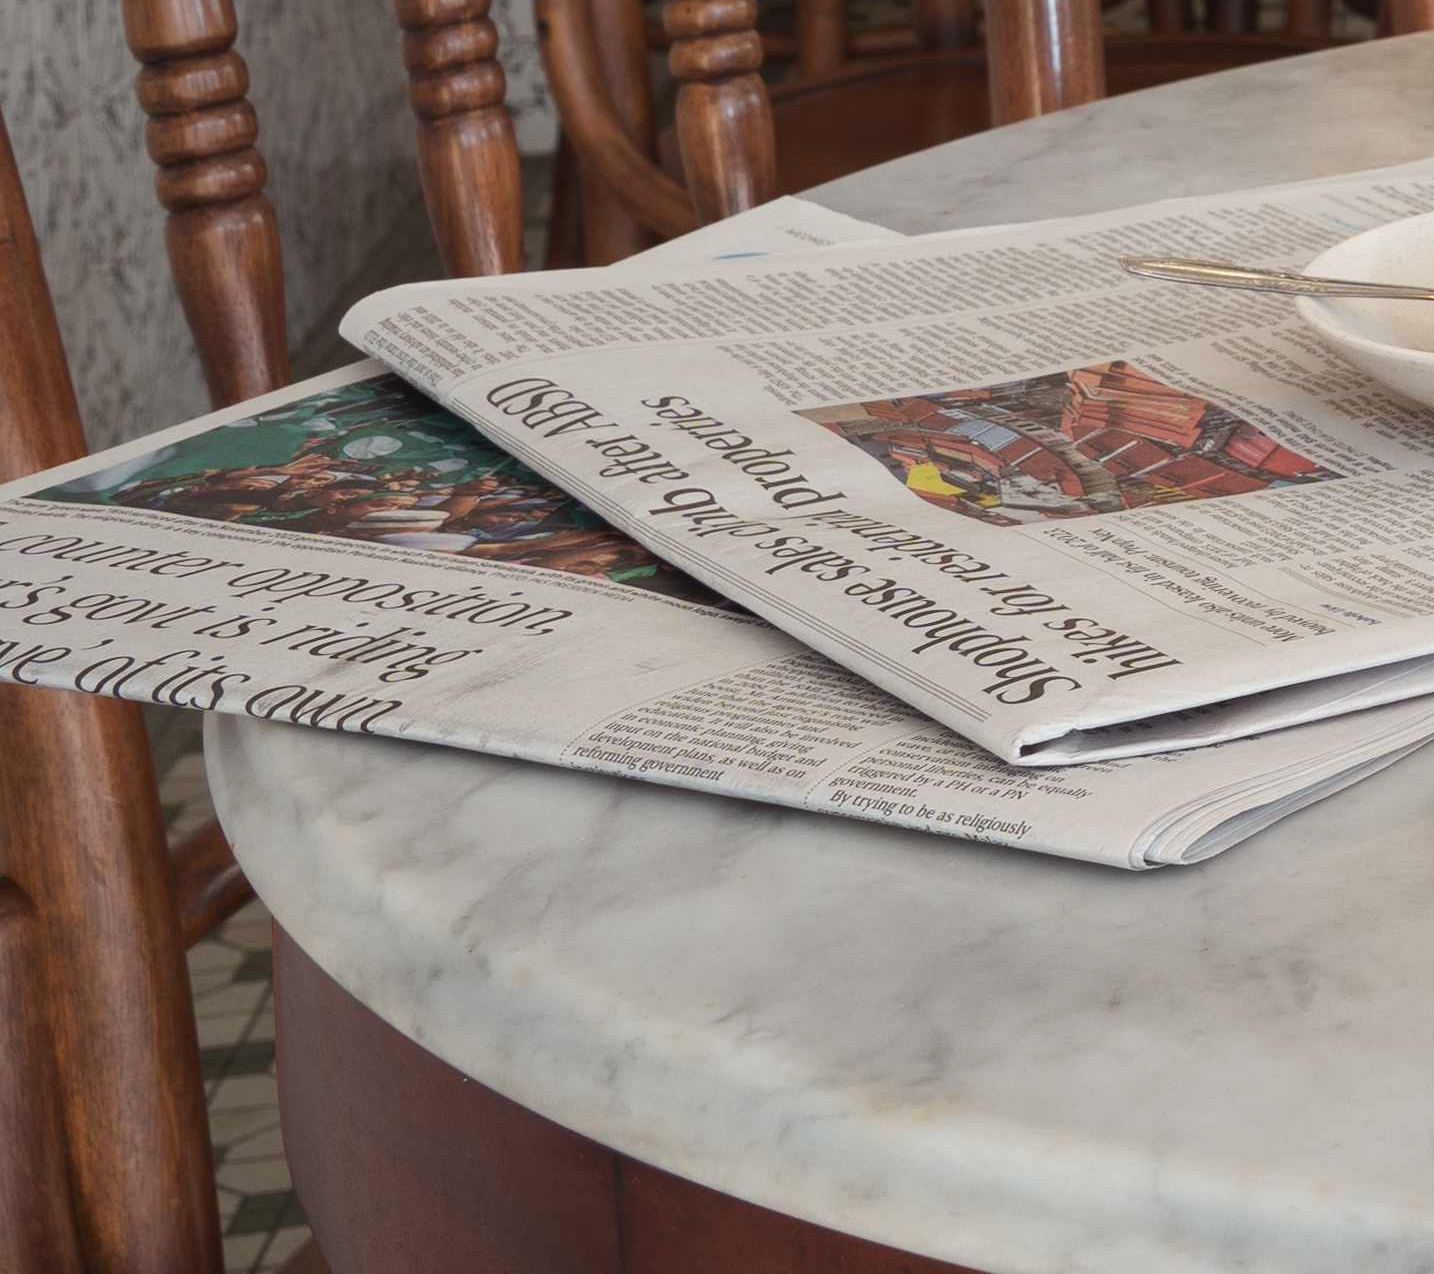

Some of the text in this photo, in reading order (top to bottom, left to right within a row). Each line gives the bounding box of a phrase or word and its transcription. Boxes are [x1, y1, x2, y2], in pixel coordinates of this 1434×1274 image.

[486, 377, 619, 438] ABSD
[585, 434, 689, 484] after
[641, 395, 847, 511] properties
[649, 487, 779, 538] climb
[218, 524, 272, 538] November
[785, 509, 1009, 583] residential
[755, 536, 870, 582] sales
[1084, 550, 1125, 564] half
[1116, 561, 1150, 574] first
[1144, 553, 1200, 581] tourism:
[0, 534, 573, 637] counter opposition,
[1144, 571, 1166, 583] in
[1150, 579, 1202, 604] leased
[1195, 575, 1267, 609] recovering
[980, 584, 1071, 616] for
[1199, 601, 1232, 617] also
[1264, 606, 1290, 620] by
[1230, 611, 1265, 628] units
[1262, 624, 1304, 643] More
[1283, 615, 1336, 636] buoyed
[22, 592, 216, 629] govt
[193, 606, 278, 640] is
[260, 621, 483, 683] riding
[844, 578, 1082, 705] Shophouse
[1044, 617, 1183, 680] hikes
[74, 649, 202, 699] of
[151, 654, 252, 712] its
[244, 682, 403, 735] own
[637, 706, 706, 722] education.
[723, 720, 755, 731] will
[749, 725, 780, 735] also
[778, 729, 799, 738] be
[799, 733, 863, 749] involved
[638, 716, 704, 732] economic
[701, 727, 766, 746] planning,
[765, 739, 815, 754] giving
[708, 710, 799, 729] programmes
[796, 725, 830, 734] and
[588, 731, 807, 779] development plans, as well as on
[603, 721, 829, 768] input on the national budget and
[879, 749, 973, 768] conservatism
[572, 746, 643, 771] reforming
[638, 758, 725, 781] government
[860, 756, 929, 771] personal
[925, 764, 984, 780] liberties,
[987, 776, 1016, 785] can
[1015, 780, 1037, 789] be
[1036, 785, 1094, 799] equally
[828, 777, 918, 798] government.
[847, 766, 917, 782] triggered
[913, 773, 935, 786] by
[945, 779, 972, 792] PH
[970, 784, 990, 794] or
[999, 788, 1030, 800] PN
[829, 789, 1033, 840] By trying to be as religiously
